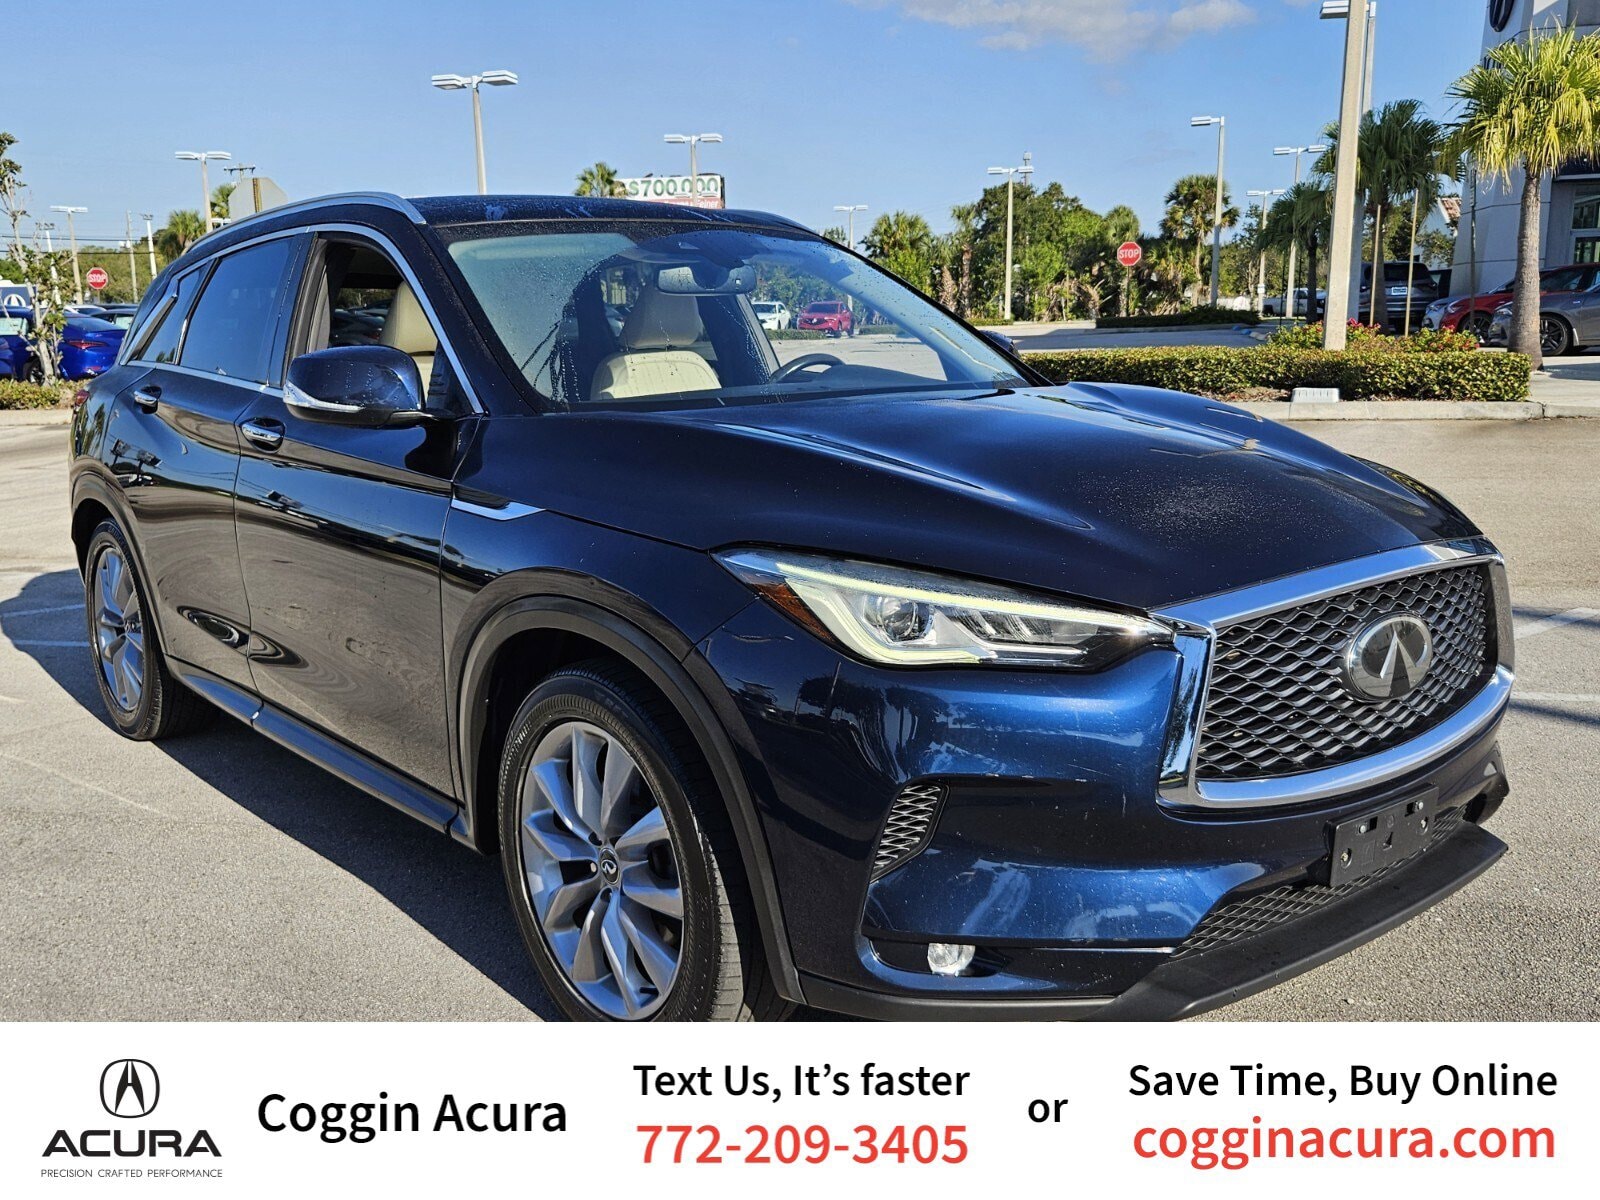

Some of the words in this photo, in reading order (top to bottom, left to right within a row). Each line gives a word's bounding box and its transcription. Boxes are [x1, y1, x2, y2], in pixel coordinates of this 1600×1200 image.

[629, 177, 719, 197] $700000
[1119, 249, 1140, 259] STOP
[87, 273, 107, 283] STOP
